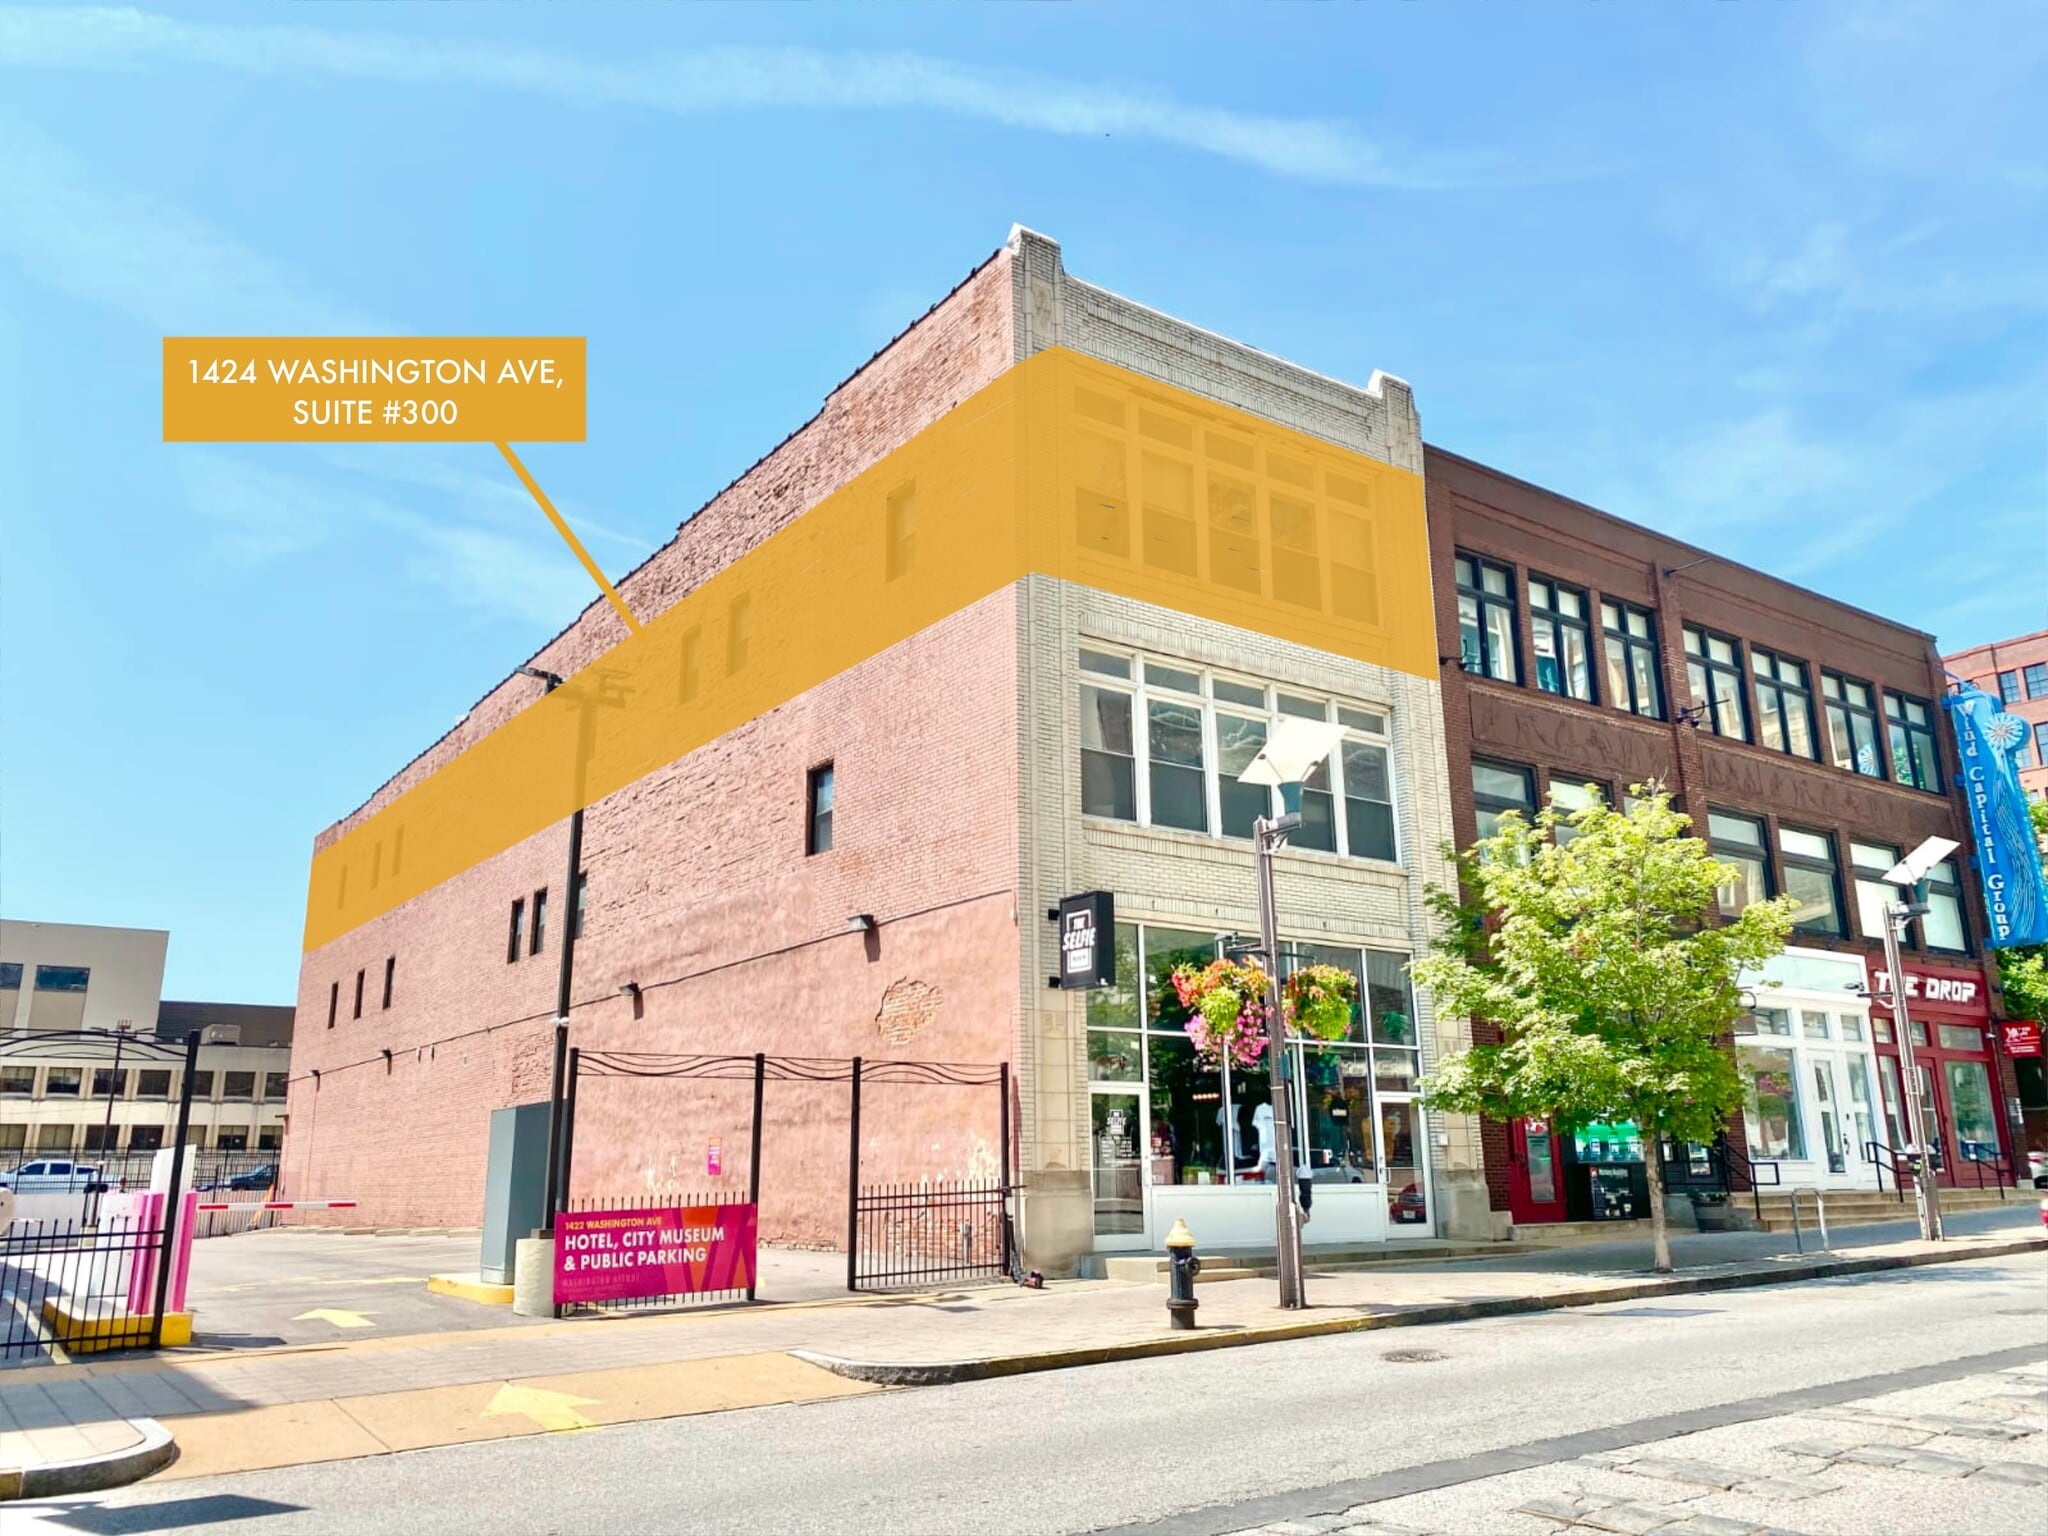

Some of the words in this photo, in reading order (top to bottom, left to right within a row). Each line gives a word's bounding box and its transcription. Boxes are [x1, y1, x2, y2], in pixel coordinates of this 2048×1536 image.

[1956, 700, 1978, 757] Wind
[1969, 766, 1996, 864] Capital
[1987, 874, 2010, 941] Group
[1062, 927, 1096, 951] SELFIE
[1874, 970, 1919, 998] TE
[1925, 977, 1976, 1003] DROP
[565, 1221, 584, 1231] 1422
[586, 1218, 644, 1230] WASHINGTON
[646, 1216, 663, 1227] AVE
[564, 1232, 618, 1251] HOTEL,
[622, 1230, 656, 1248] CITY
[659, 1226, 725, 1245] MUSEUM
[563, 1255, 576, 1272] &
[580, 1251, 634, 1271] PUBLIC
[637, 1247, 707, 1267] PARKING
